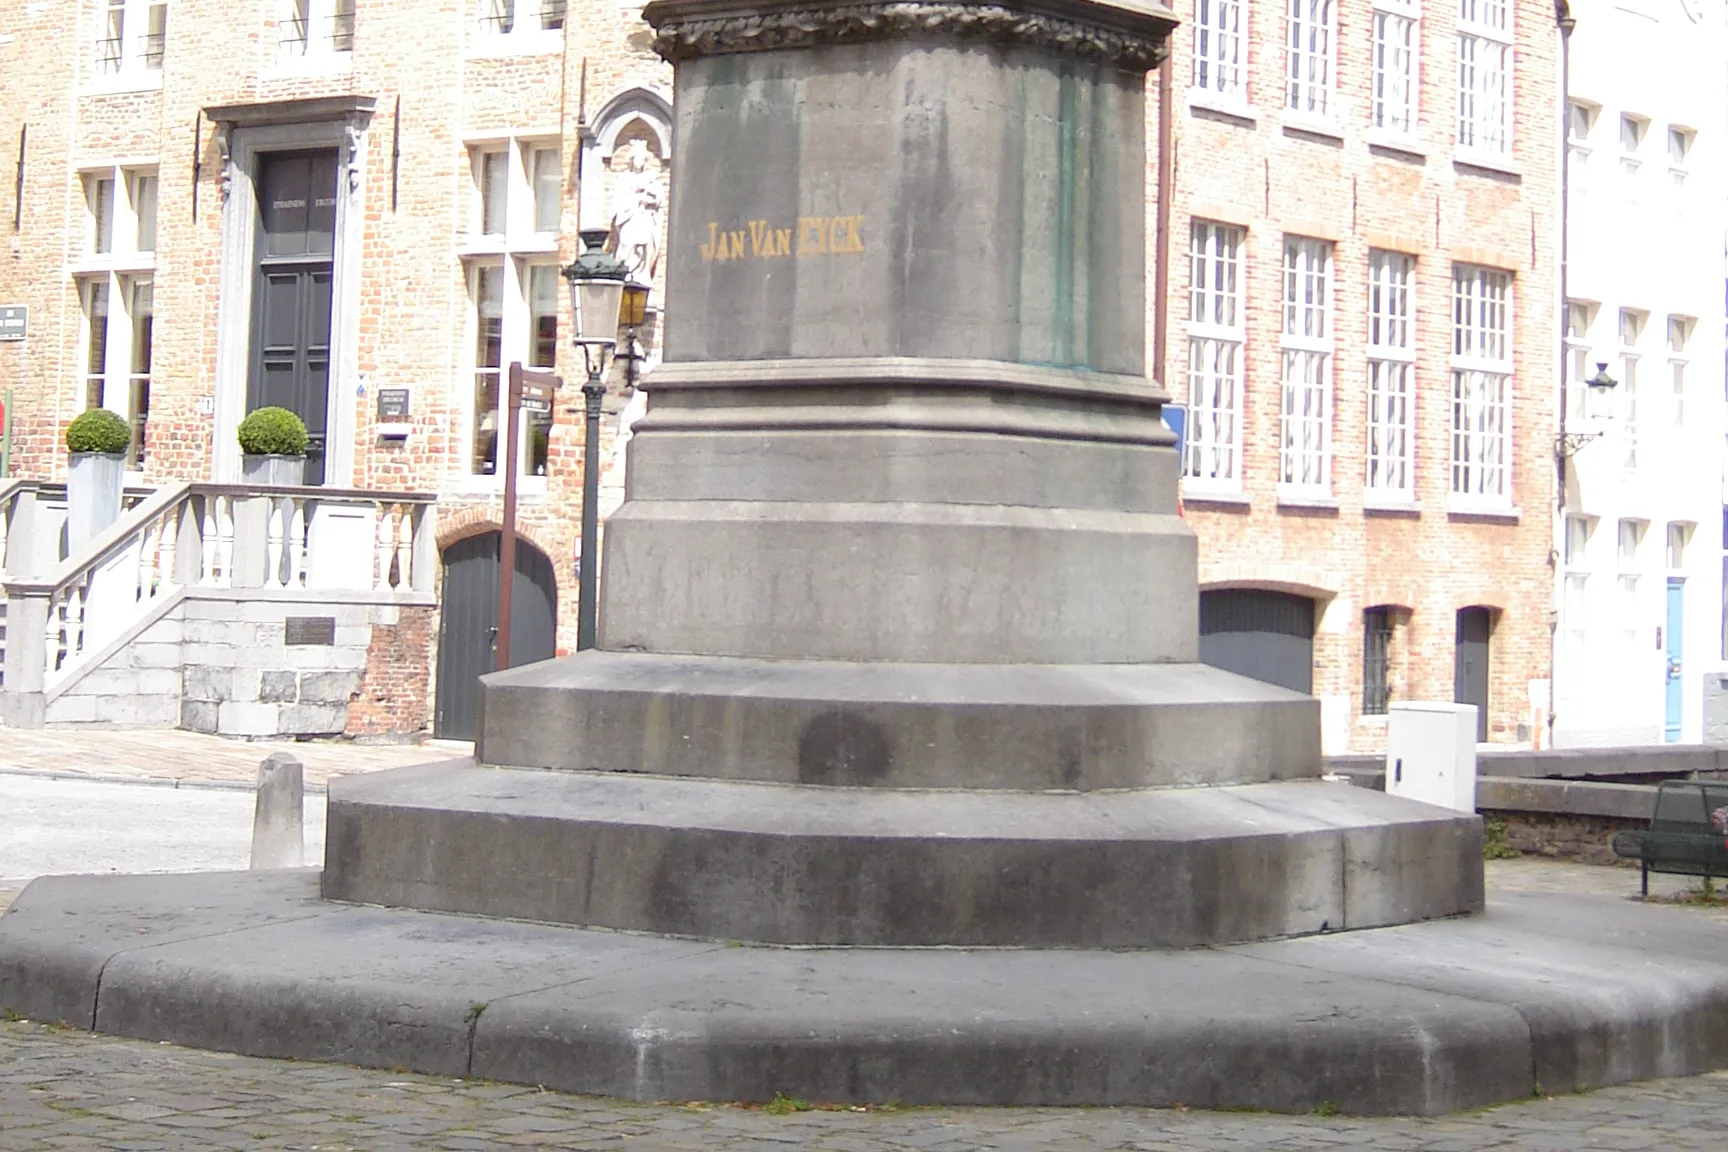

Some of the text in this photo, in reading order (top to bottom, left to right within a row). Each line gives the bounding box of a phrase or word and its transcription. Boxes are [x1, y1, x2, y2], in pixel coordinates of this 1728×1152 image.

[701, 215, 864, 260] JAN VAN EYCK
